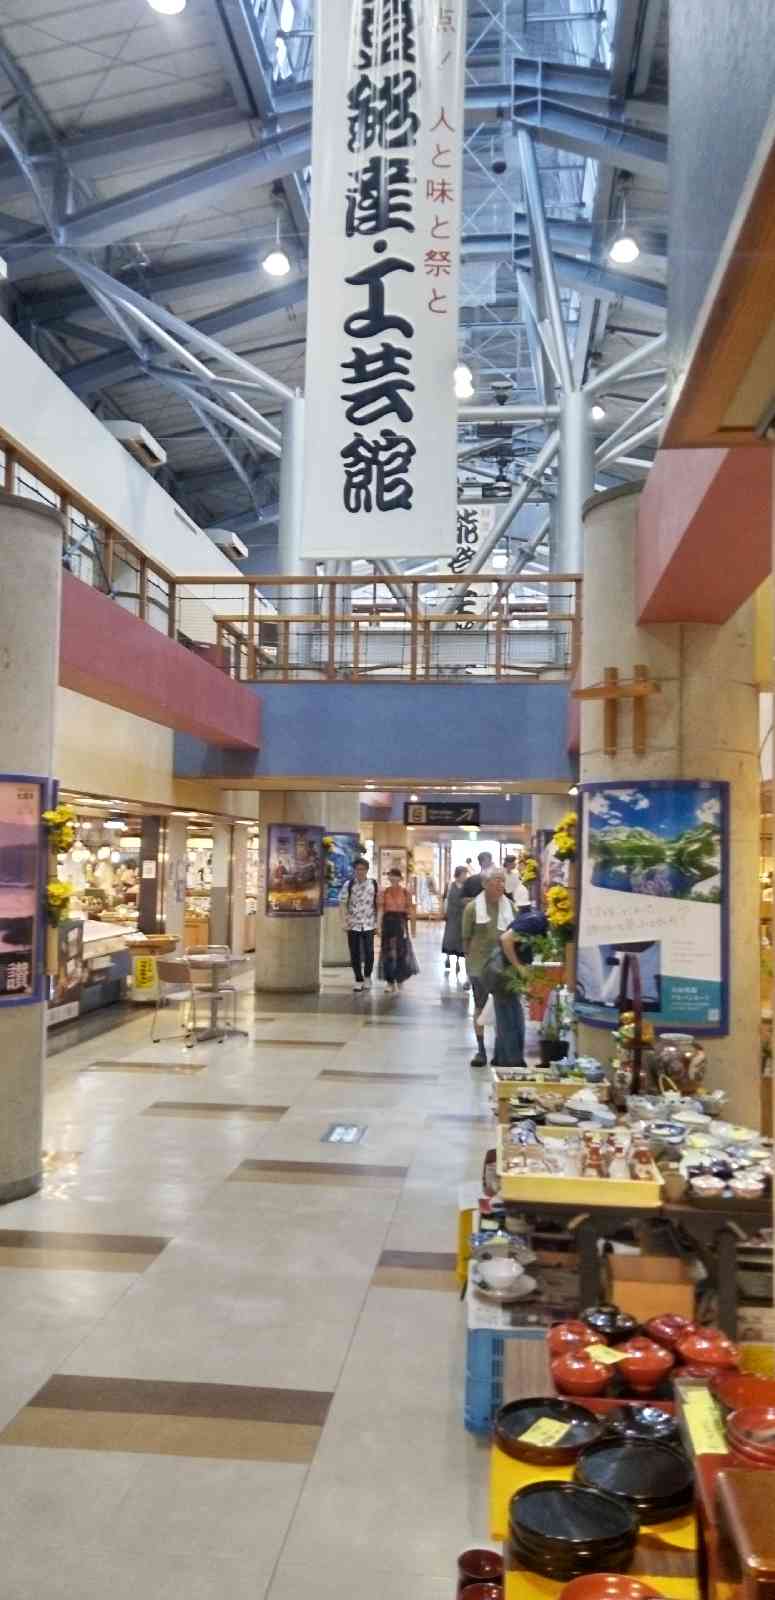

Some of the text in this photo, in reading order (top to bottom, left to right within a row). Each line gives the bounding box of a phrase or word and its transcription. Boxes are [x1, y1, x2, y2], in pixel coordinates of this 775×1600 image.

[423, 107, 456, 315] 人と味と祭と
